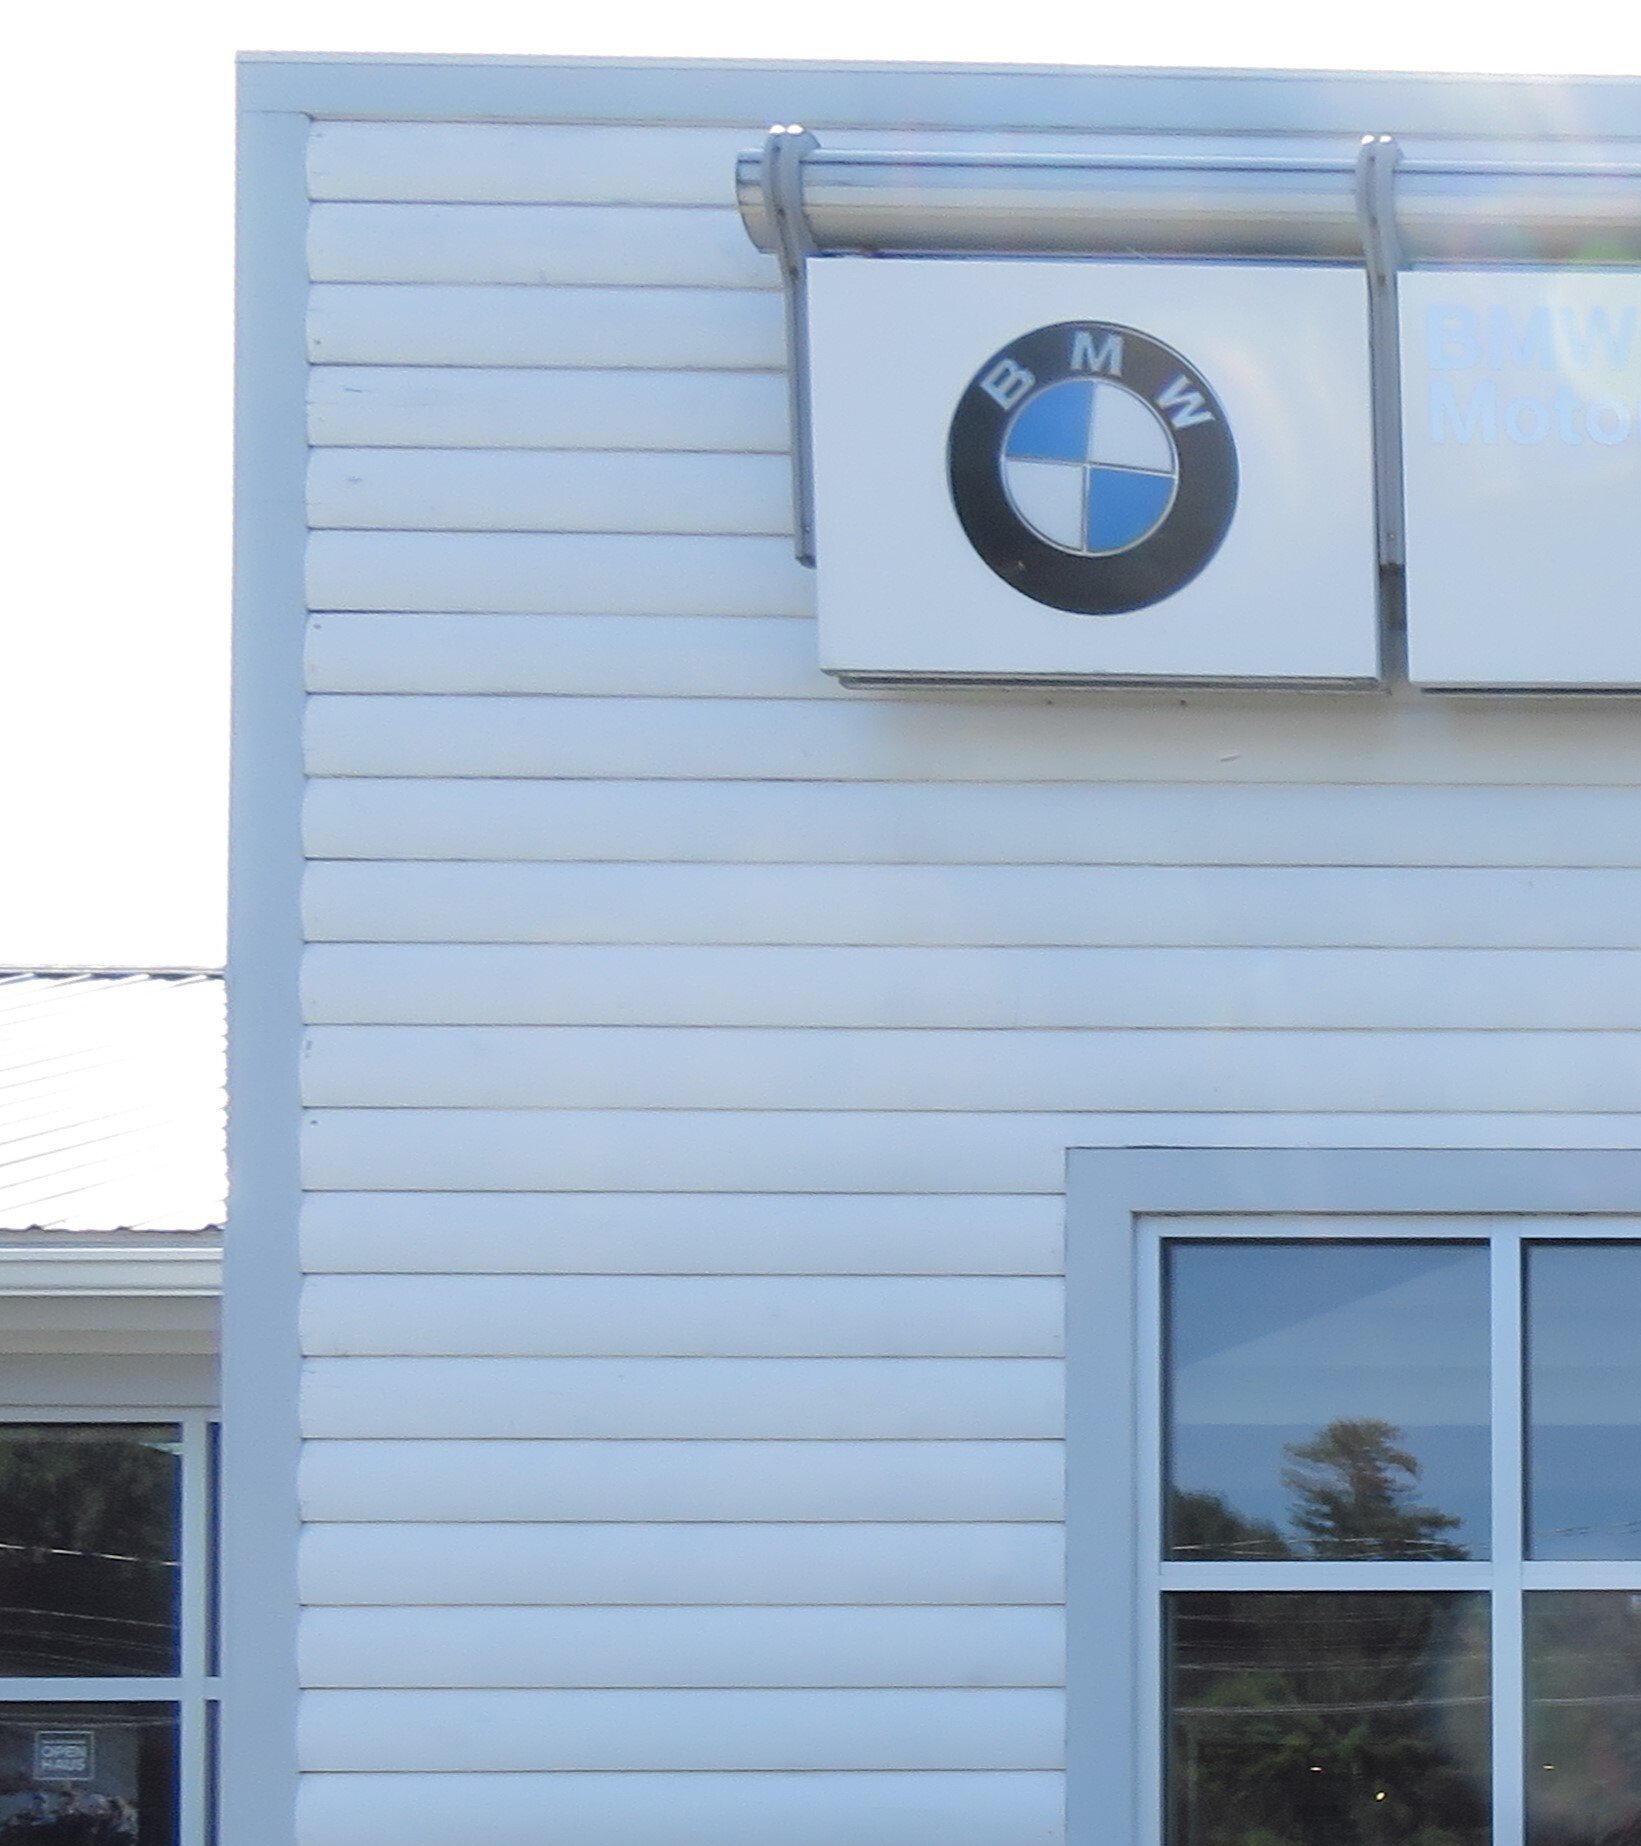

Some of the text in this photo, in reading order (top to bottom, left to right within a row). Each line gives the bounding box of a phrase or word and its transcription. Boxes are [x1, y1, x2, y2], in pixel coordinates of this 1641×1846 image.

[1425, 302, 1640, 371] BMW
[980, 329, 1217, 429] BMW
[42, 1745, 87, 1758] OPEN
